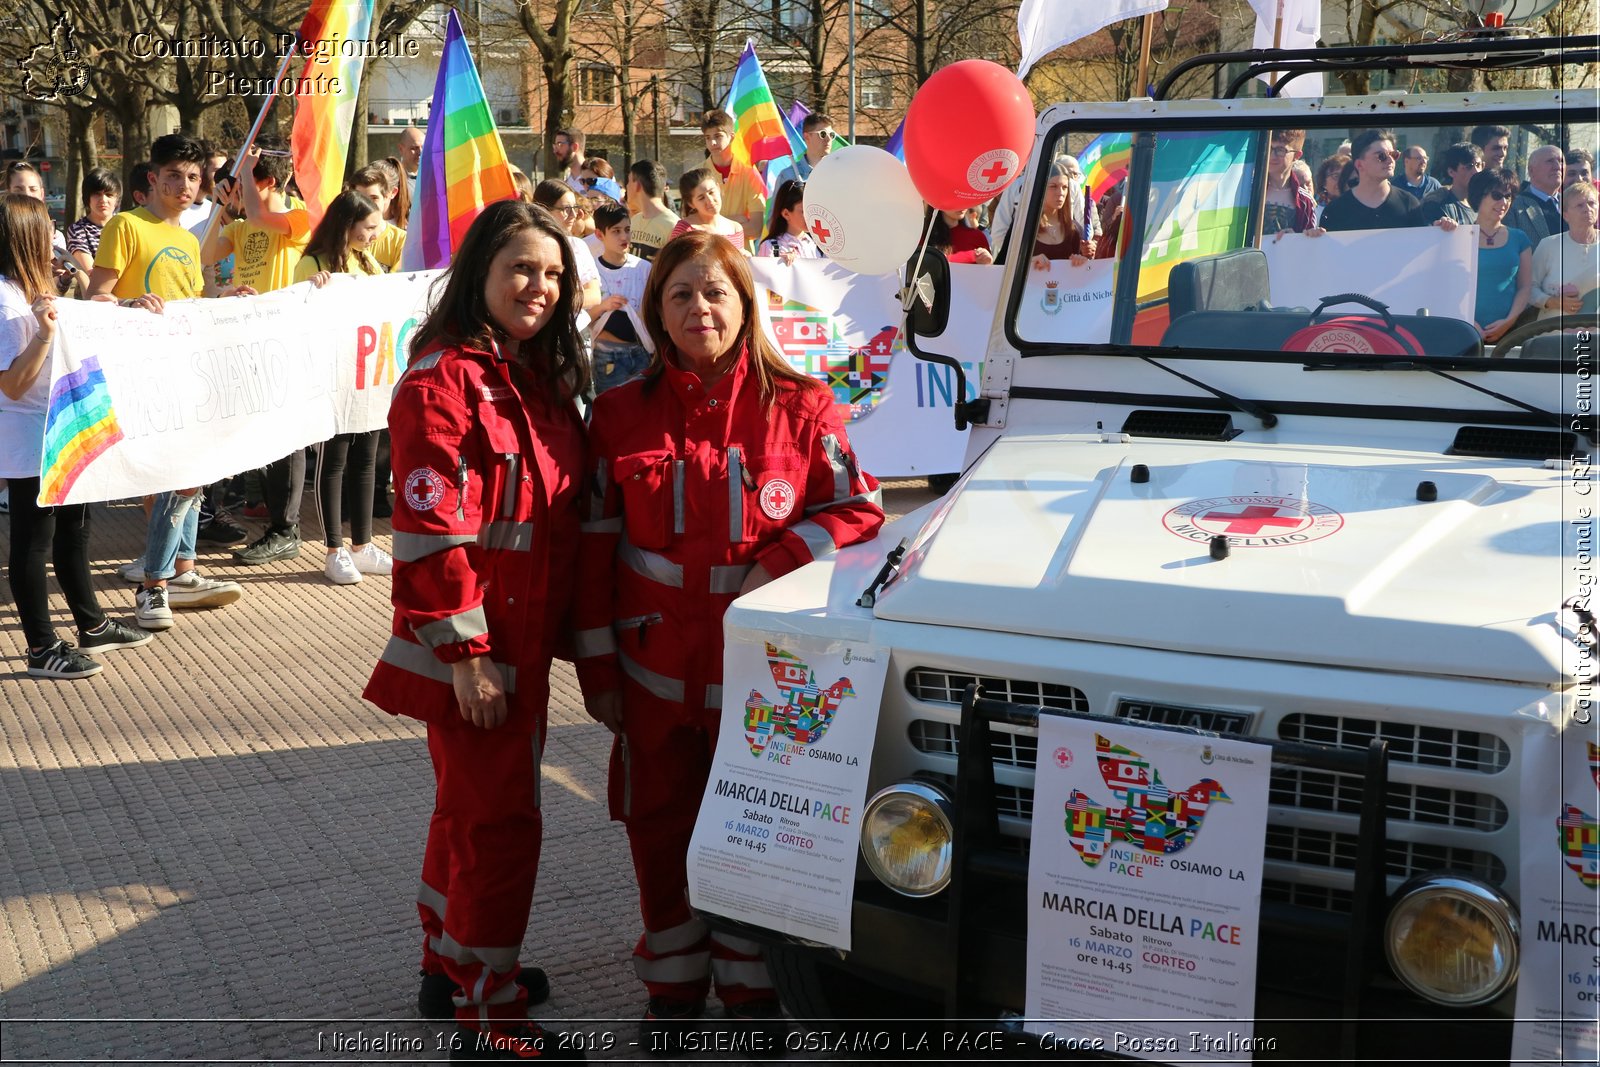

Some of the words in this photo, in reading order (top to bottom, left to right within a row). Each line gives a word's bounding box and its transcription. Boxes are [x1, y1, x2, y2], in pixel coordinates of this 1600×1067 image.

[1063, 293, 1080, 303] Città
[1082, 292, 1091, 302] di
[1321, 332, 1357, 343] ROSSA
[190, 338, 289, 424] SIAMO
[1173, 499, 1223, 517] CROCE
[1227, 496, 1285, 505] ROSSA
[1127, 706, 1240, 733] FIAT
[767, 751, 792, 766] PACE
[770, 740, 806, 756] INSIEME:
[808, 748, 843, 763] OSIAMO
[846, 755, 859, 767] LA
[714, 779, 767, 806] MARCIA
[769, 791, 810, 816] DELLA
[812, 801, 852, 825] PACE
[742, 808, 773, 825] Sabato
[779, 817, 801, 828] Ritrovo
[724, 820, 734, 830] 16
[735, 822, 770, 839] MARZO
[727, 834, 743, 846] ore
[744, 840, 767, 854] 14.45
[775, 832, 814, 850] CORTEO
[1109, 861, 1144, 878] PACE
[1110, 848, 1164, 868] INSIEME:
[1170, 859, 1223, 877] OSIAMO
[1229, 868, 1245, 881] LA
[1042, 891, 1118, 922] MARCIA
[1123, 906, 1185, 936] DELLA
[1190, 918, 1241, 946] PACE
[1089, 925, 1133, 944] Sabato
[1142, 935, 1173, 947] Ritrovo
[1536, 920, 1600, 947] MARC
[1068, 937, 1081, 948] 16
[1085, 940, 1133, 959] MARZO
[1077, 953, 1098, 965] ore
[1101, 958, 1133, 974] 14.45
[1142, 952, 1196, 971] CORTEO
[1567, 972, 1582, 985] 16
